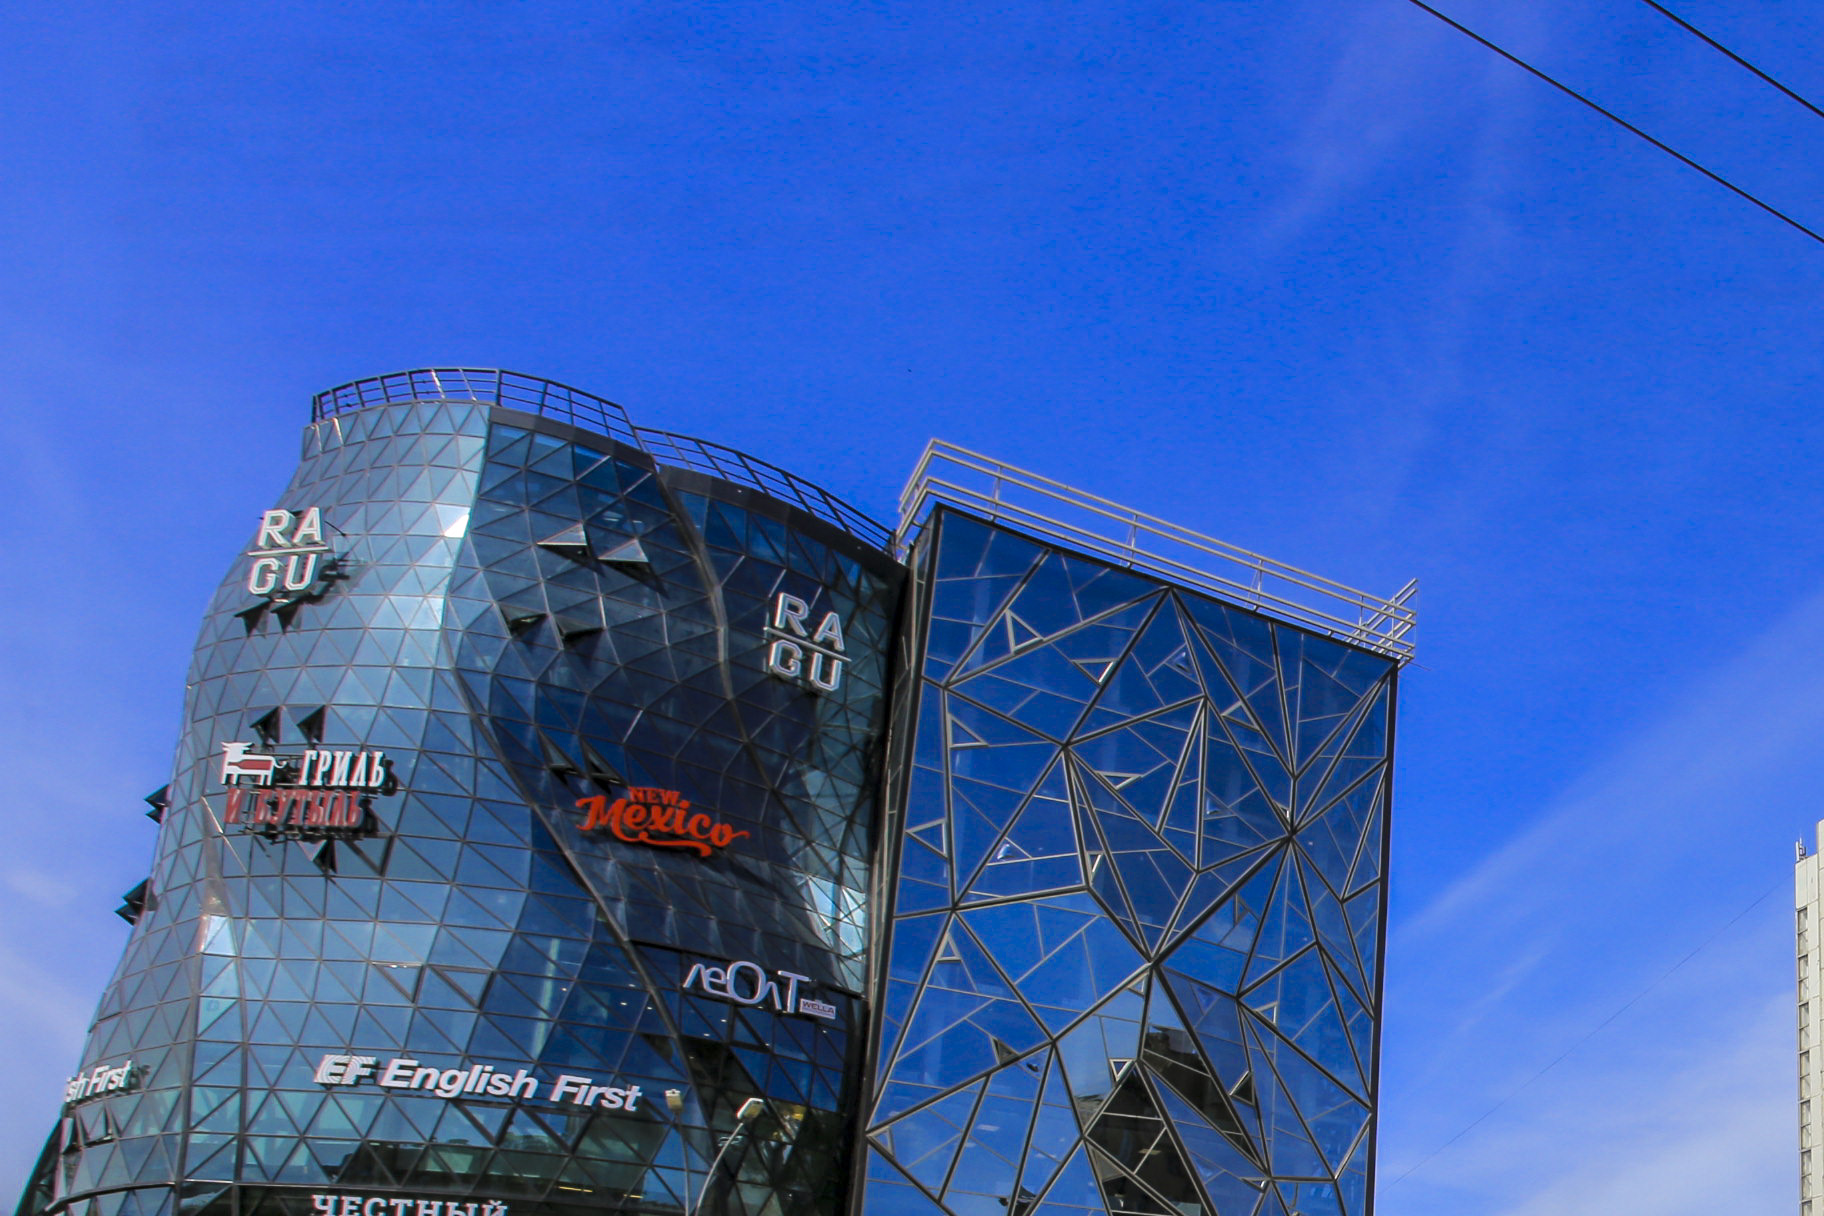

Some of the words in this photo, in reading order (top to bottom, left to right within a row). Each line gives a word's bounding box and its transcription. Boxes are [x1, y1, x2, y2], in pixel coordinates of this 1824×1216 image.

[257, 506, 327, 550] RA
[248, 553, 319, 596] GU
[774, 592, 845, 652] RA
[769, 639, 843, 692] GU
[299, 749, 387, 788] ГРИЛЬ
[225, 788, 244, 824] И
[253, 788, 364, 828] БУТЫЛЬ
[627, 786, 681, 807] NEW
[574, 795, 750, 857] Mexico
[801, 1000, 835, 1017] WELLA
[313, 1053, 377, 1086] EF
[379, 1057, 540, 1101] English
[549, 1074, 643, 1112] First
